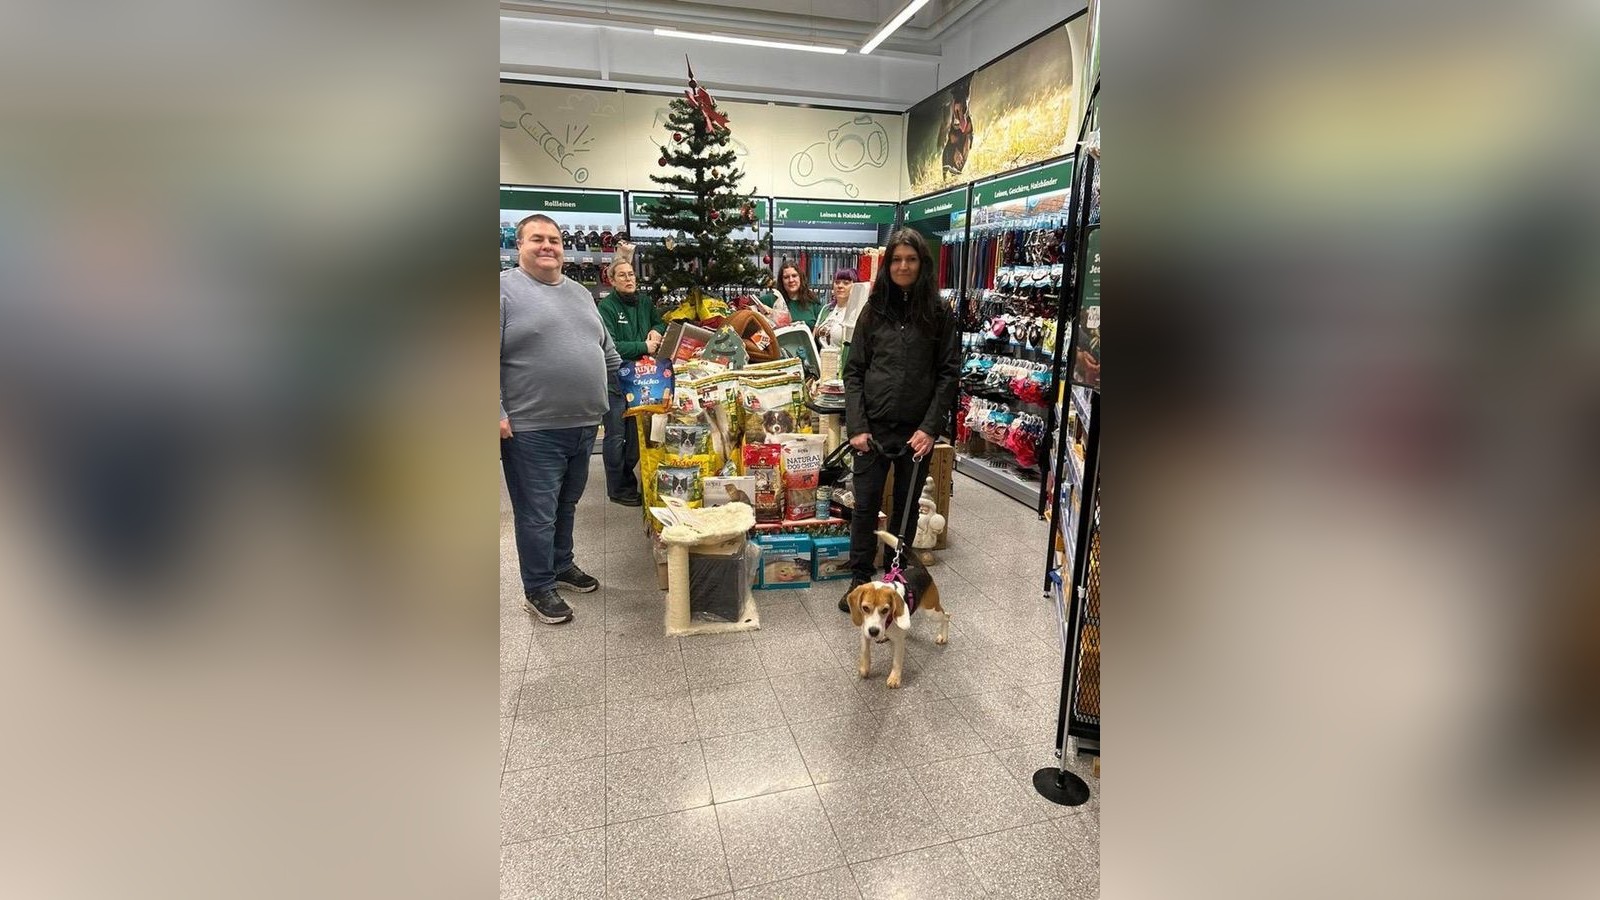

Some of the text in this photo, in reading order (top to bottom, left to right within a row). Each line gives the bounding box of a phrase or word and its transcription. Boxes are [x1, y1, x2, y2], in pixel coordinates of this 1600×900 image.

[994, 178, 1058, 199] Leinen, Geschirre, Halsbänder
